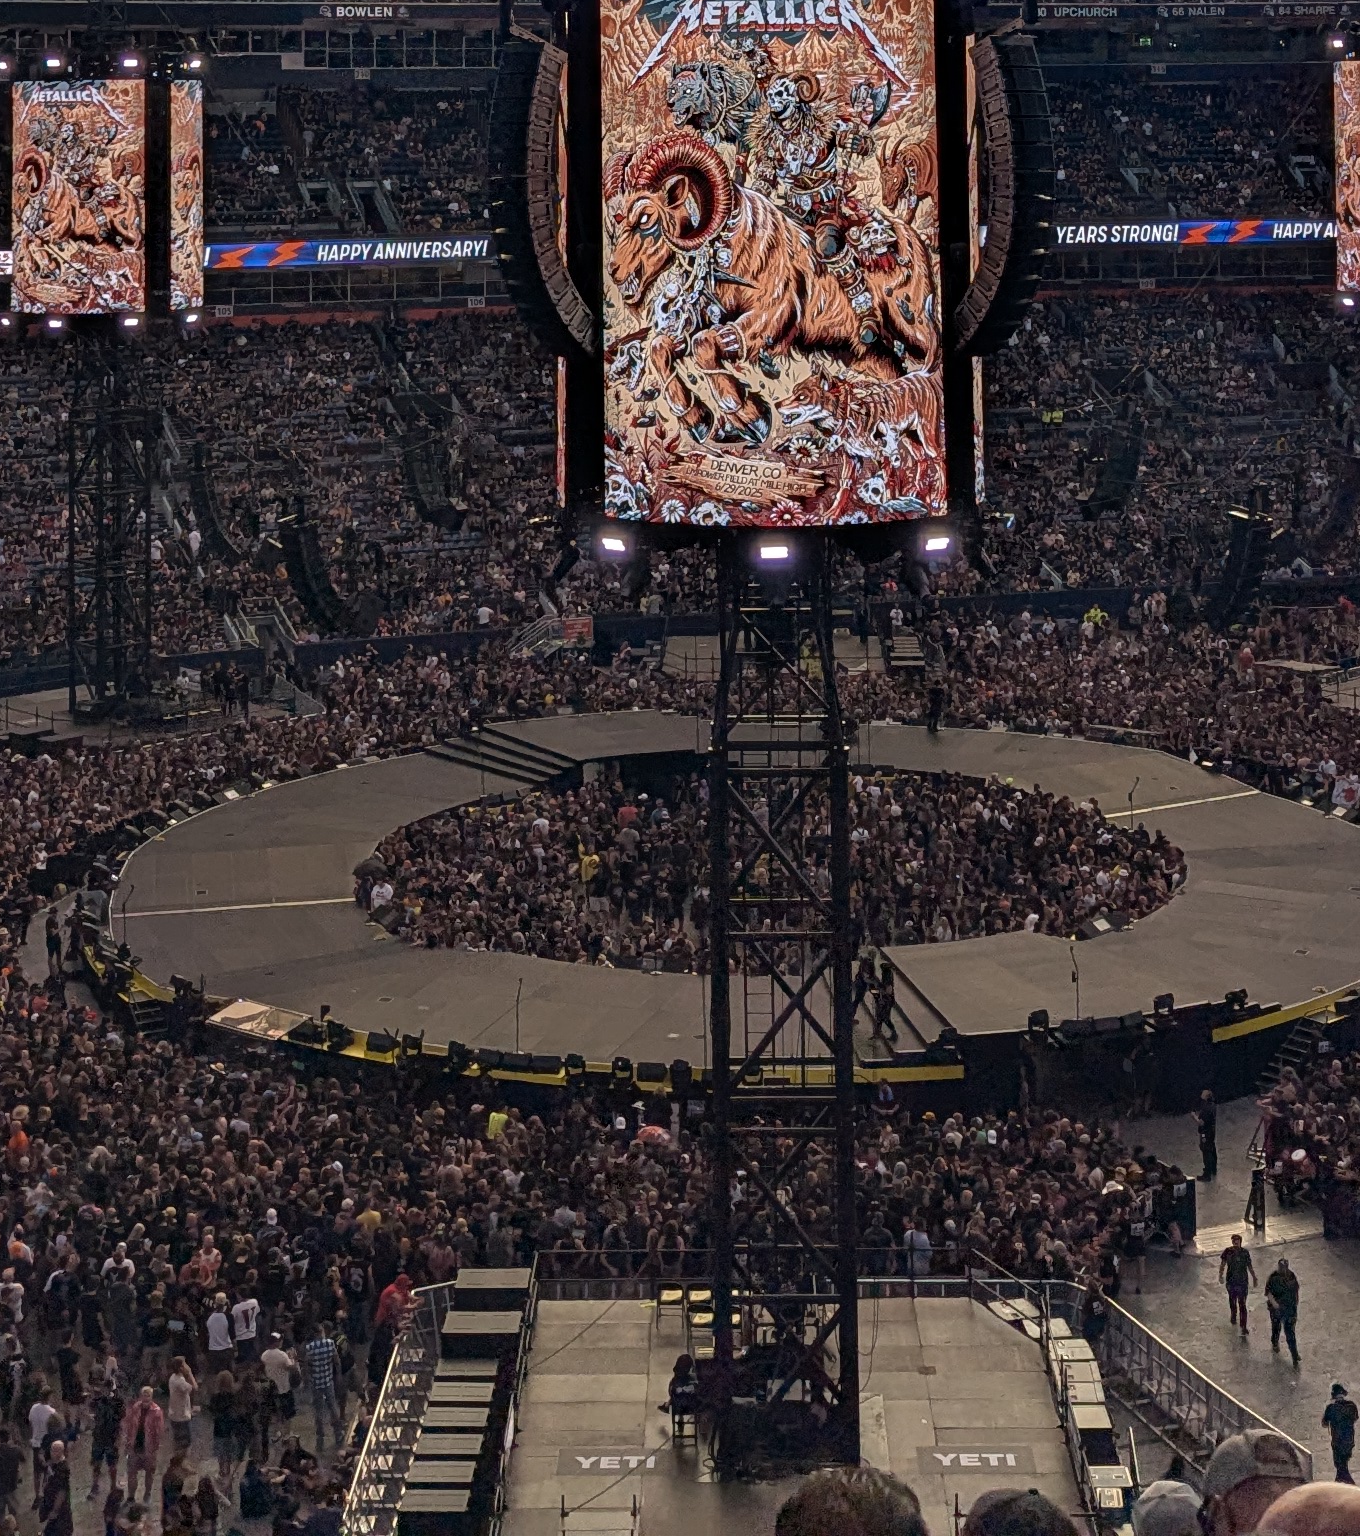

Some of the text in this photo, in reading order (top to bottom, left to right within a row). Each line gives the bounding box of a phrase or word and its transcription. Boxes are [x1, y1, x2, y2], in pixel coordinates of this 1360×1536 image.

[336, 7, 393, 17] BOWLEN
[1053, 7, 1118, 17] UPCHURCH
[1188, 7, 1225, 16] NALEN
[1294, 6, 1336, 16] SHARPE
[1056, 224, 1179, 244] YEARS STRONG!
[1272, 223, 1323, 241] HAPPY
[317, 240, 487, 262] HAPPY ANNIVERSARY!
[469, 298, 483, 306] 106
[763, 467, 781, 479] CO
[715, 482, 762, 498] 6/29/2025
[725, 474, 747, 484] FIELD
[748, 478, 759, 486] AT
[760, 479, 782, 490] MILE
[783, 483, 807, 493] HIGH
[575, 1455, 656, 1469] YETI
[932, 1453, 1017, 1467] YETI
